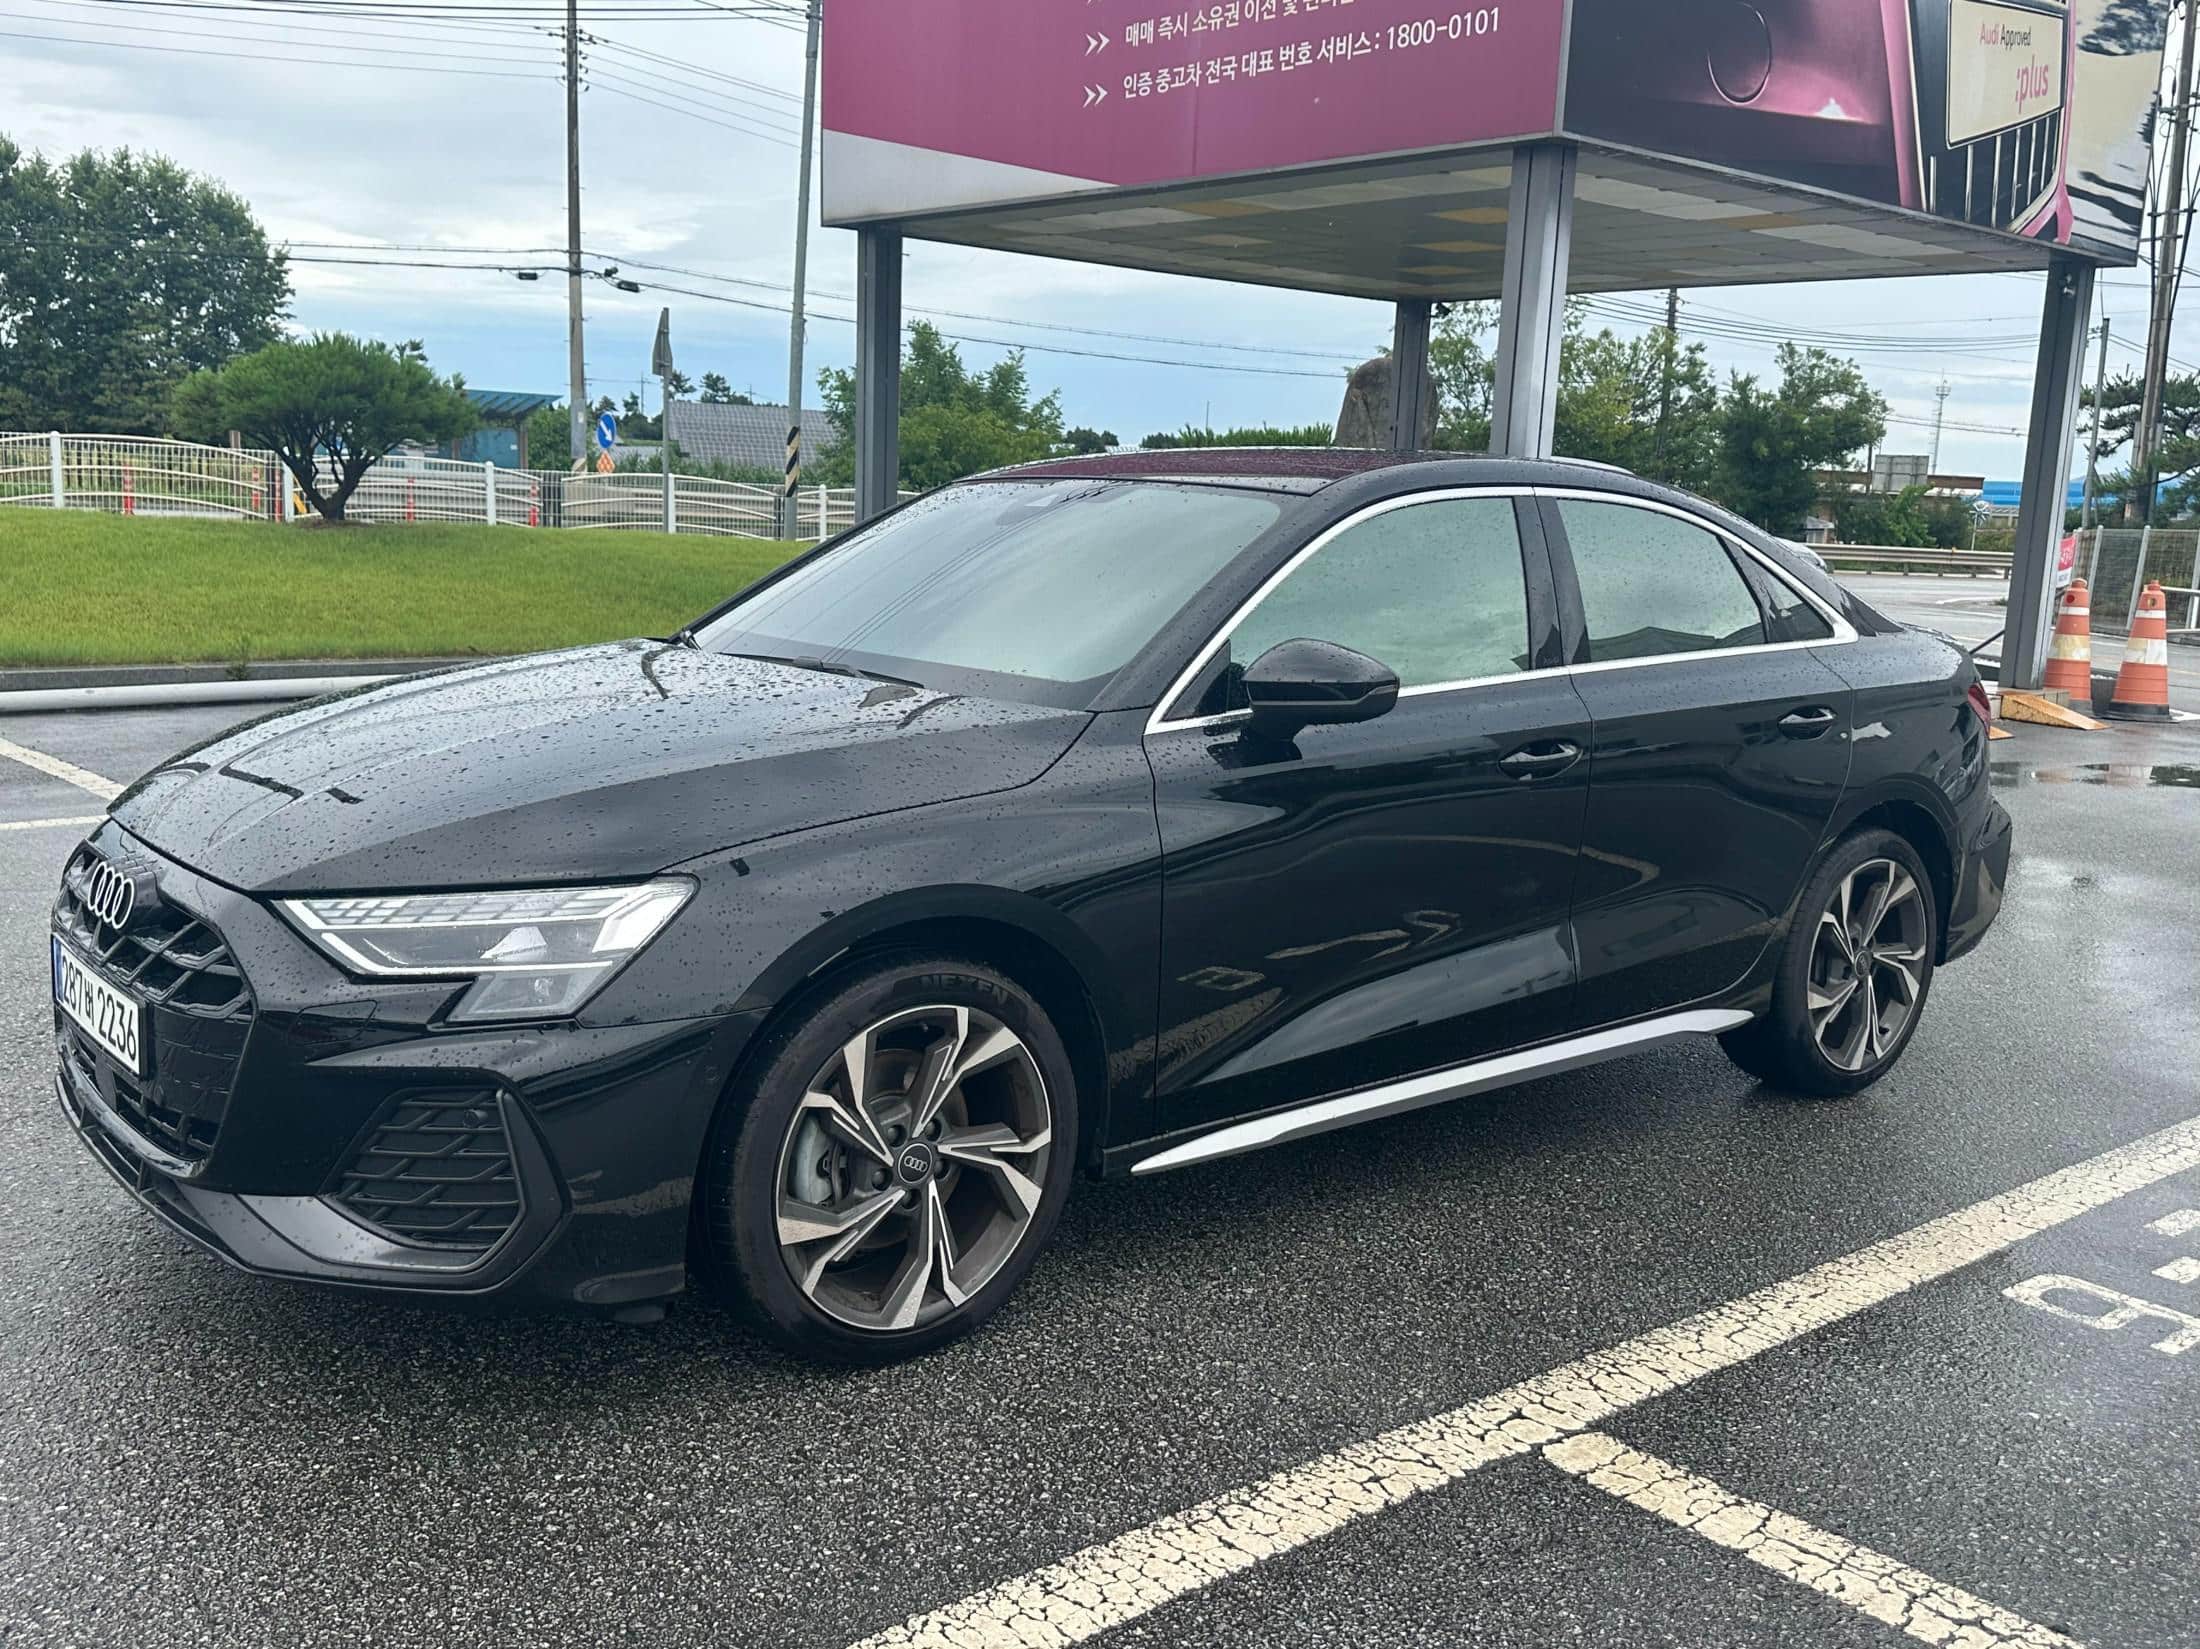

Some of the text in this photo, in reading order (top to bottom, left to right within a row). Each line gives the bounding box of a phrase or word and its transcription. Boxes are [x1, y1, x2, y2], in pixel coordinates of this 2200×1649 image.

[1123, 71, 1153, 99] 인증
[1155, 61, 1202, 93] 중고차
[1205, 54, 1238, 84] 전국
[1241, 49, 1275, 77] 대표
[1279, 40, 1313, 72] 번호
[1386, 6, 1501, 50] 1800-0101
[1125, 19, 1154, 47] 매매
[1158, 12, 1188, 40] 즉시
[1191, 1, 1240, 32] 소유권
[1979, 23, 2031, 51] Audi Approved
[97, 985, 137, 1062] 2236
